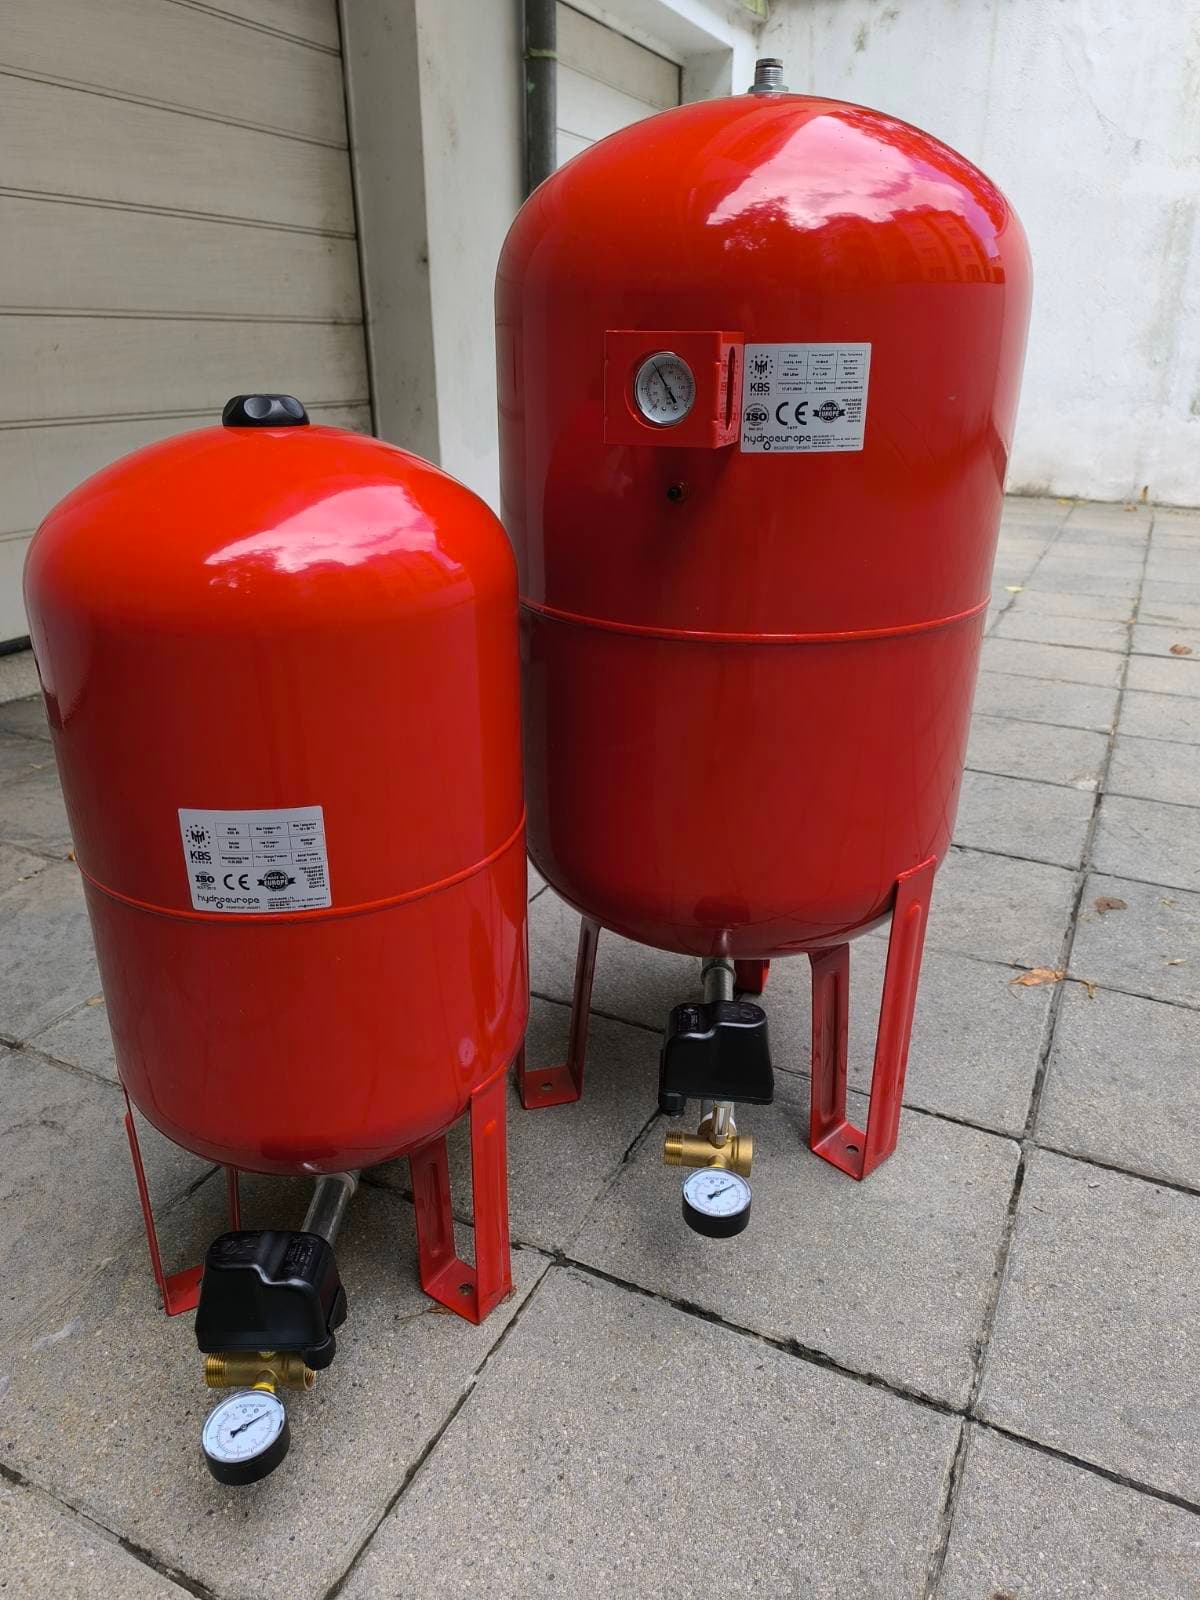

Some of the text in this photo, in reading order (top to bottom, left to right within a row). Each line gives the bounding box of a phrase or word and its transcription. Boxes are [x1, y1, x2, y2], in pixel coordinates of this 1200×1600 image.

[750, 382, 770, 392] KBS
[745, 412, 767, 422] ISO
[775, 401, 809, 426] CE
[743, 433, 811, 445] hydroeurope
[189, 850, 212, 861] KBS
[195, 874, 215, 883] ISO
[223, 873, 250, 890] CE
[197, 894, 260, 906] hydroeurope
